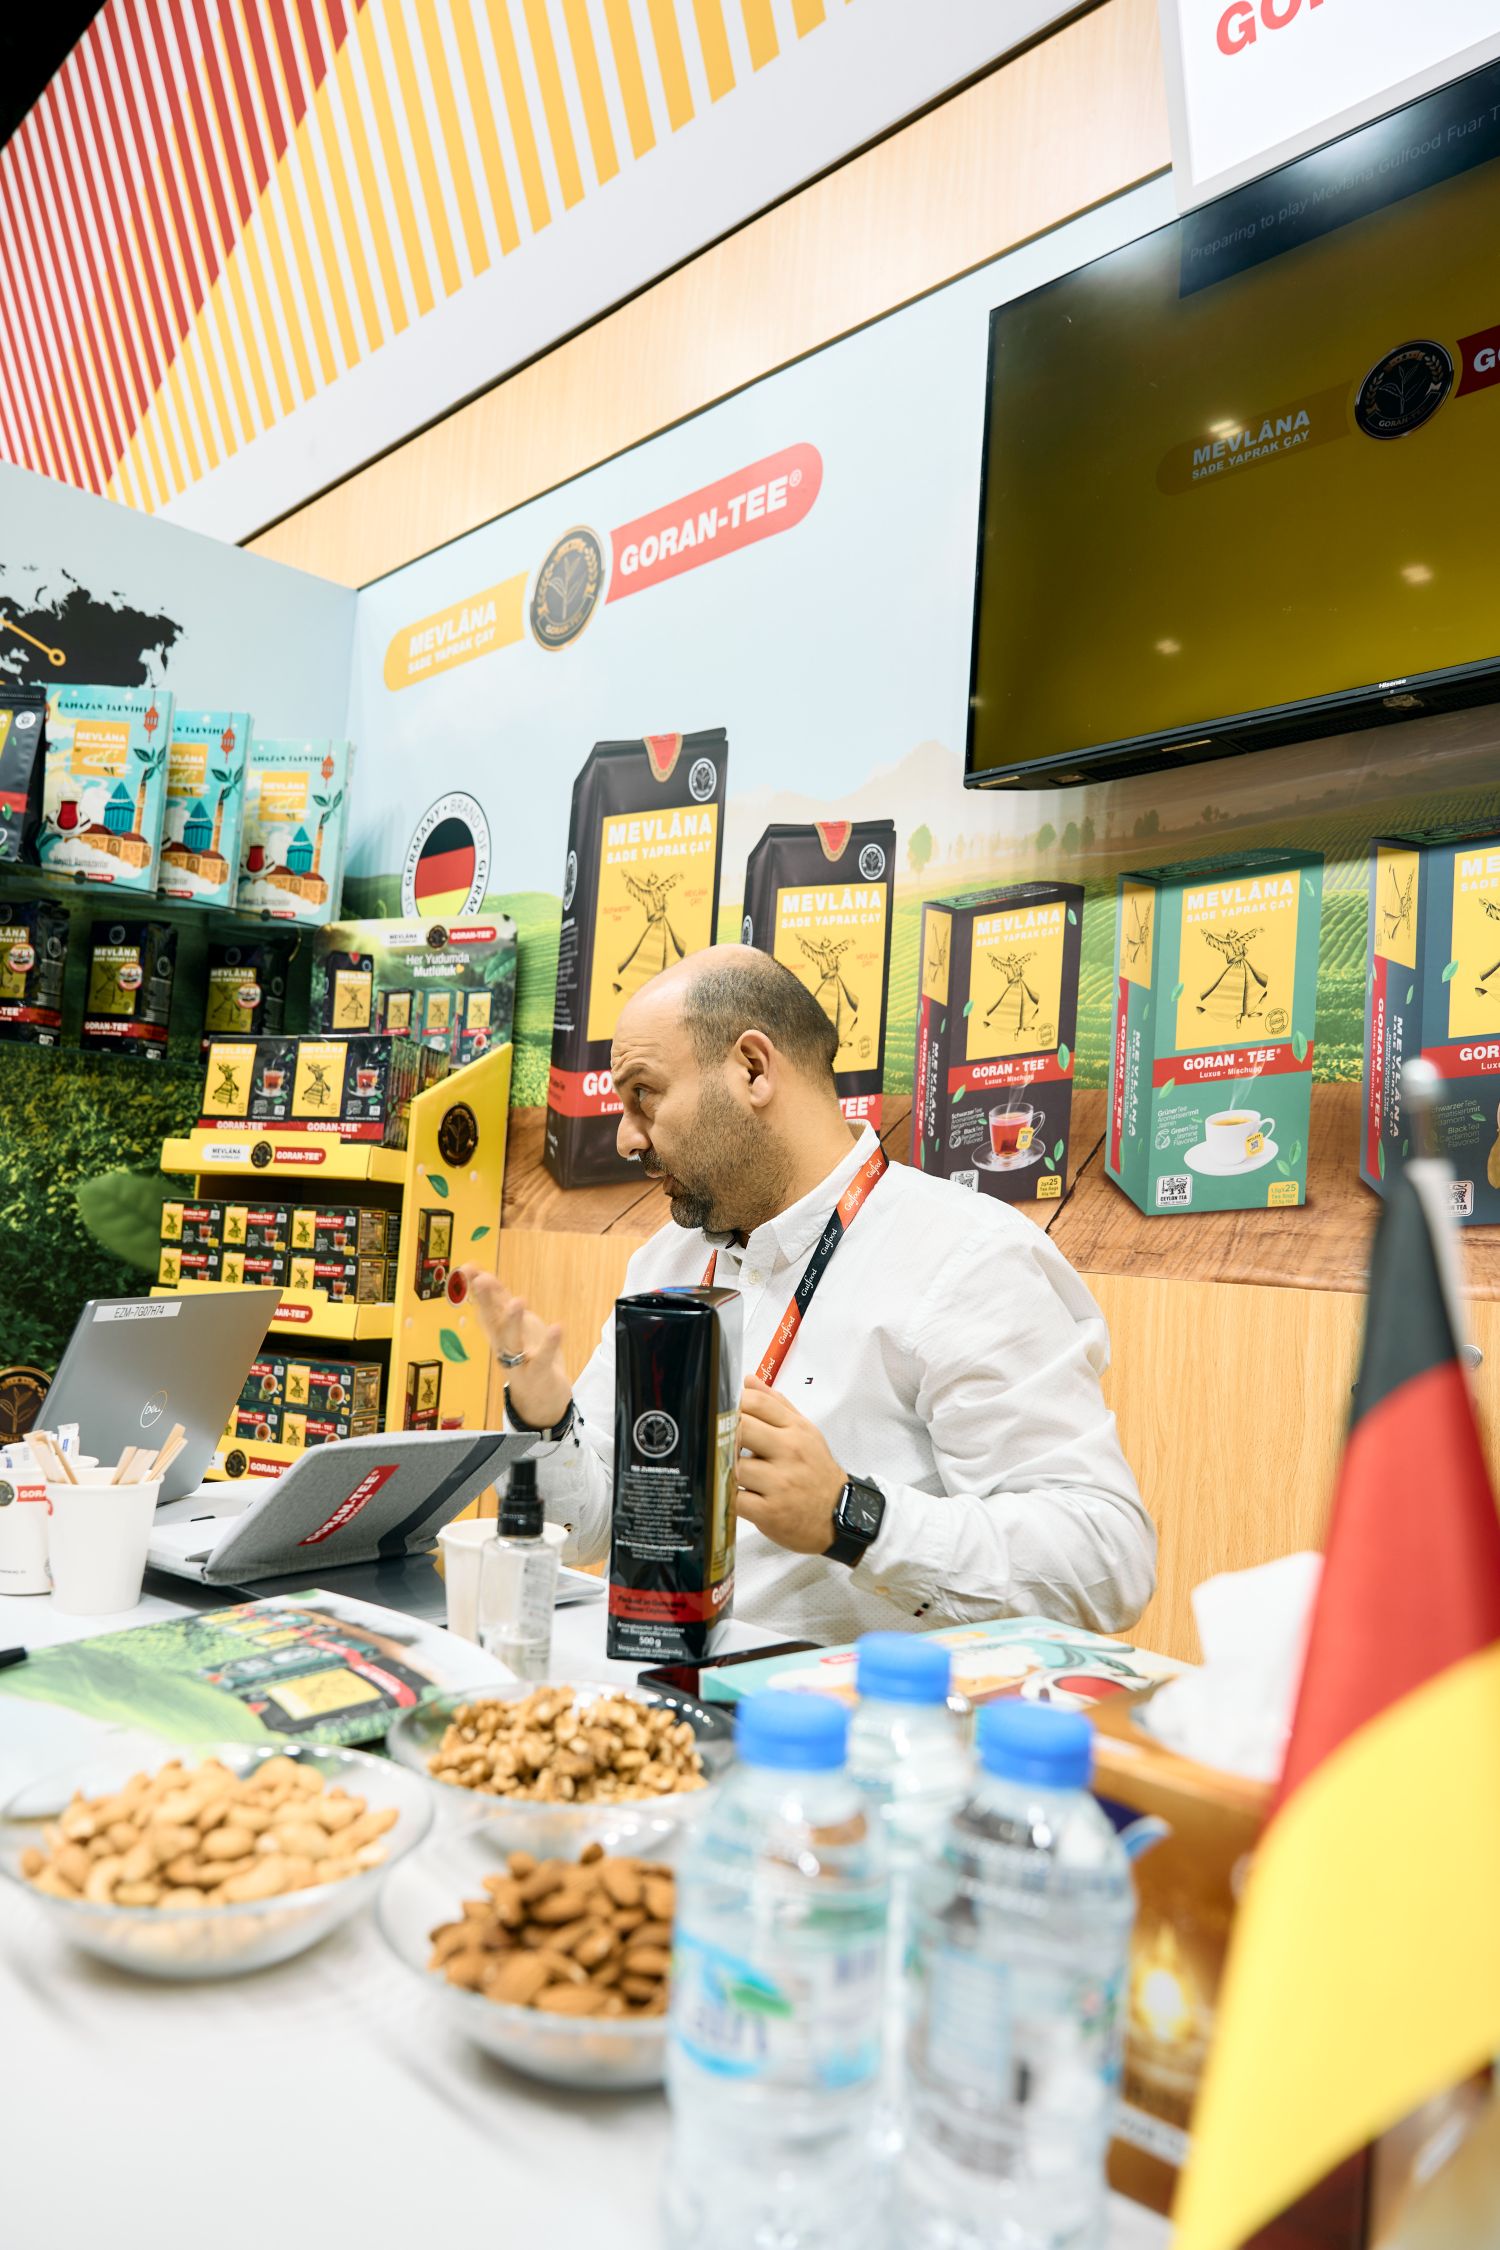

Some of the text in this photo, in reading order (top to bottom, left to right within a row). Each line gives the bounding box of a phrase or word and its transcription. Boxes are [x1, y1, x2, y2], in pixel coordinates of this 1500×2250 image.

[1216, 0, 1324, 55] GO
[1189, 221, 1256, 261] Preparing
[1260, 213, 1275, 230] to
[1278, 198, 1309, 224] play
[1379, 133, 1442, 174] Gulfood
[1447, 114, 1487, 142] Fuar
[1192, 409, 1311, 466] MEVLÂNA
[1192, 430, 1310, 480] SADE YAPRAK ÇAY
[409, 600, 497, 657] MEVLÂNA
[407, 626, 496, 675] SADE YAPRAK ÇAY
[1377, 678, 1407, 689] Hisense
[450, 798, 481, 829] BRAND
[606, 811, 713, 847] MEVLÂNA
[607, 840, 712, 864] SADE YAPRAK ÇAY
[465, 859, 487, 915] GERM
[1187, 879, 1293, 911] MEVLÂNA
[782, 888, 882, 914] MEVLÂNA
[1187, 899, 1293, 924] SADE YAPRAK ÇAY
[782, 912, 881, 929] SADE YAPRAK ÇAY
[976, 908, 1060, 935] MEVLÂNA
[976, 937, 1000, 947] SADE
[1003, 930, 1040, 942] YAPRAK
[406, 952, 470, 966] Her Yudumda
[413, 964, 456, 977] Mutluluk
[1376, 998, 1384, 1072] GORAN
[972, 1064, 1013, 1078] GORAN
[1183, 1054, 1234, 1071] GORAN
[1199, 1070, 1221, 1079] Luxus
[866, 1158, 883, 1179] Gulfood
[844, 1186, 863, 1211] Gulfood
[820, 1228, 838, 1256] Gulfood
[801, 1268, 818, 1297] Gulfood
[114, 1305, 165, 1319] EZM-7G07H74
[778, 1315, 796, 1345] Gulfood
[760, 1357, 776, 1384] ulfood
[639, 1635, 654, 1645] 500
